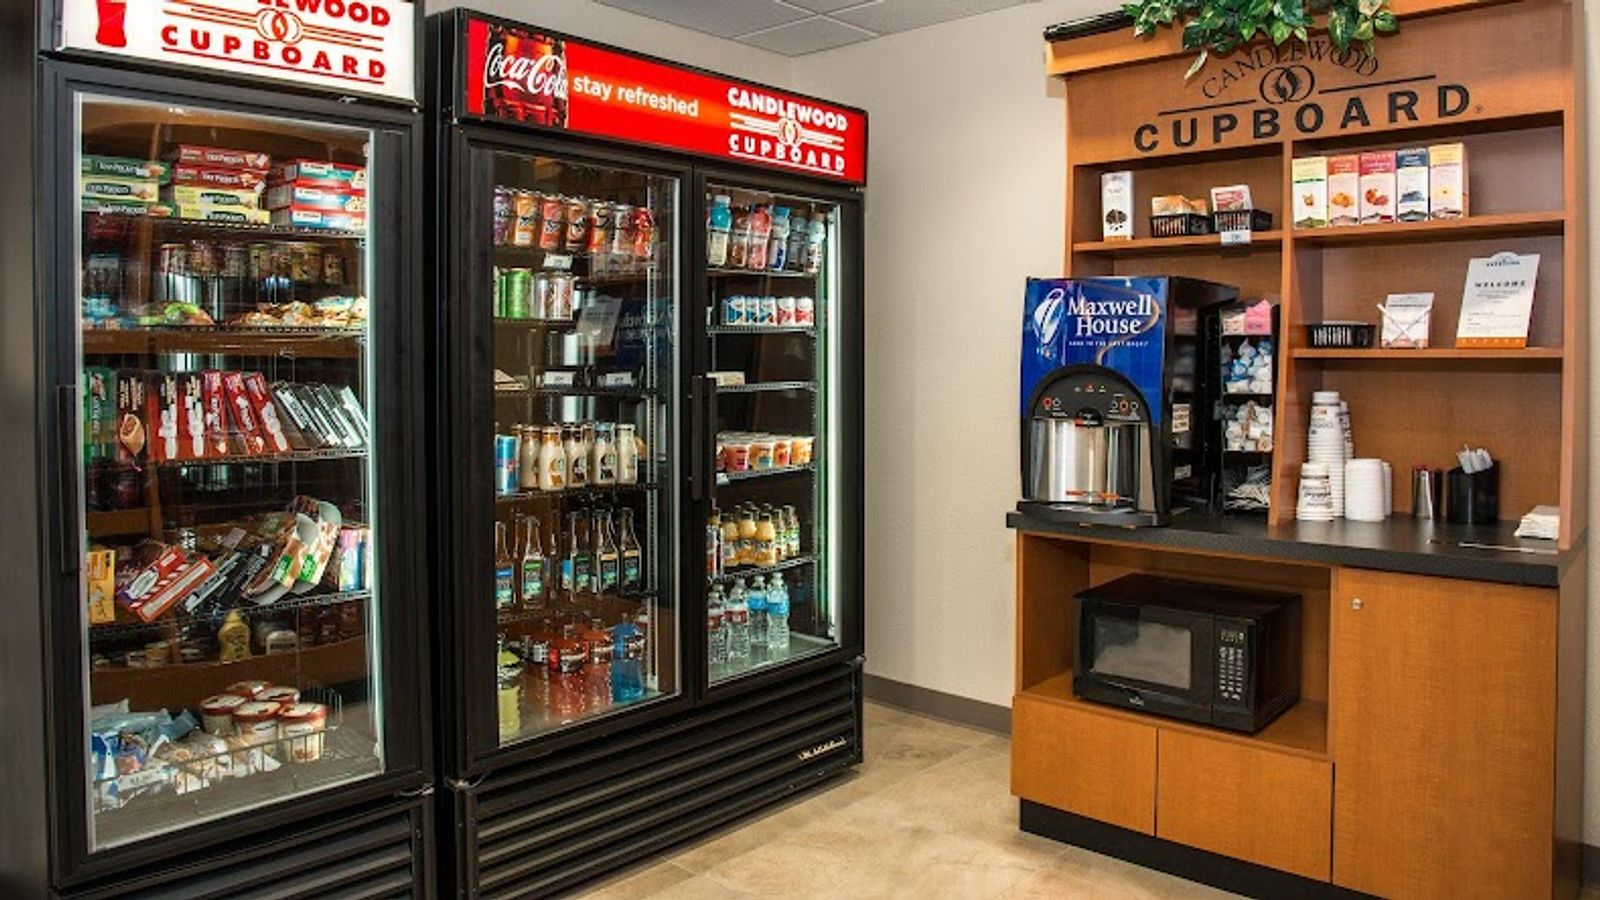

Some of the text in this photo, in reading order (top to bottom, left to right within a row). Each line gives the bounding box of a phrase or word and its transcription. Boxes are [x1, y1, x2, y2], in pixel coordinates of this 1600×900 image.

[161, 25, 386, 79] CUPBOARD
[1202, 40, 1379, 99] CANDLEWOOD
[573, 74, 699, 116] stay refreshed
[727, 86, 849, 132] CANDLEWOOD
[1133, 83, 1471, 153] CUPBOARD
[728, 134, 846, 172] CUPBOARD
[1067, 294, 1152, 316] Maxwell
[1076, 315, 1142, 337] House
